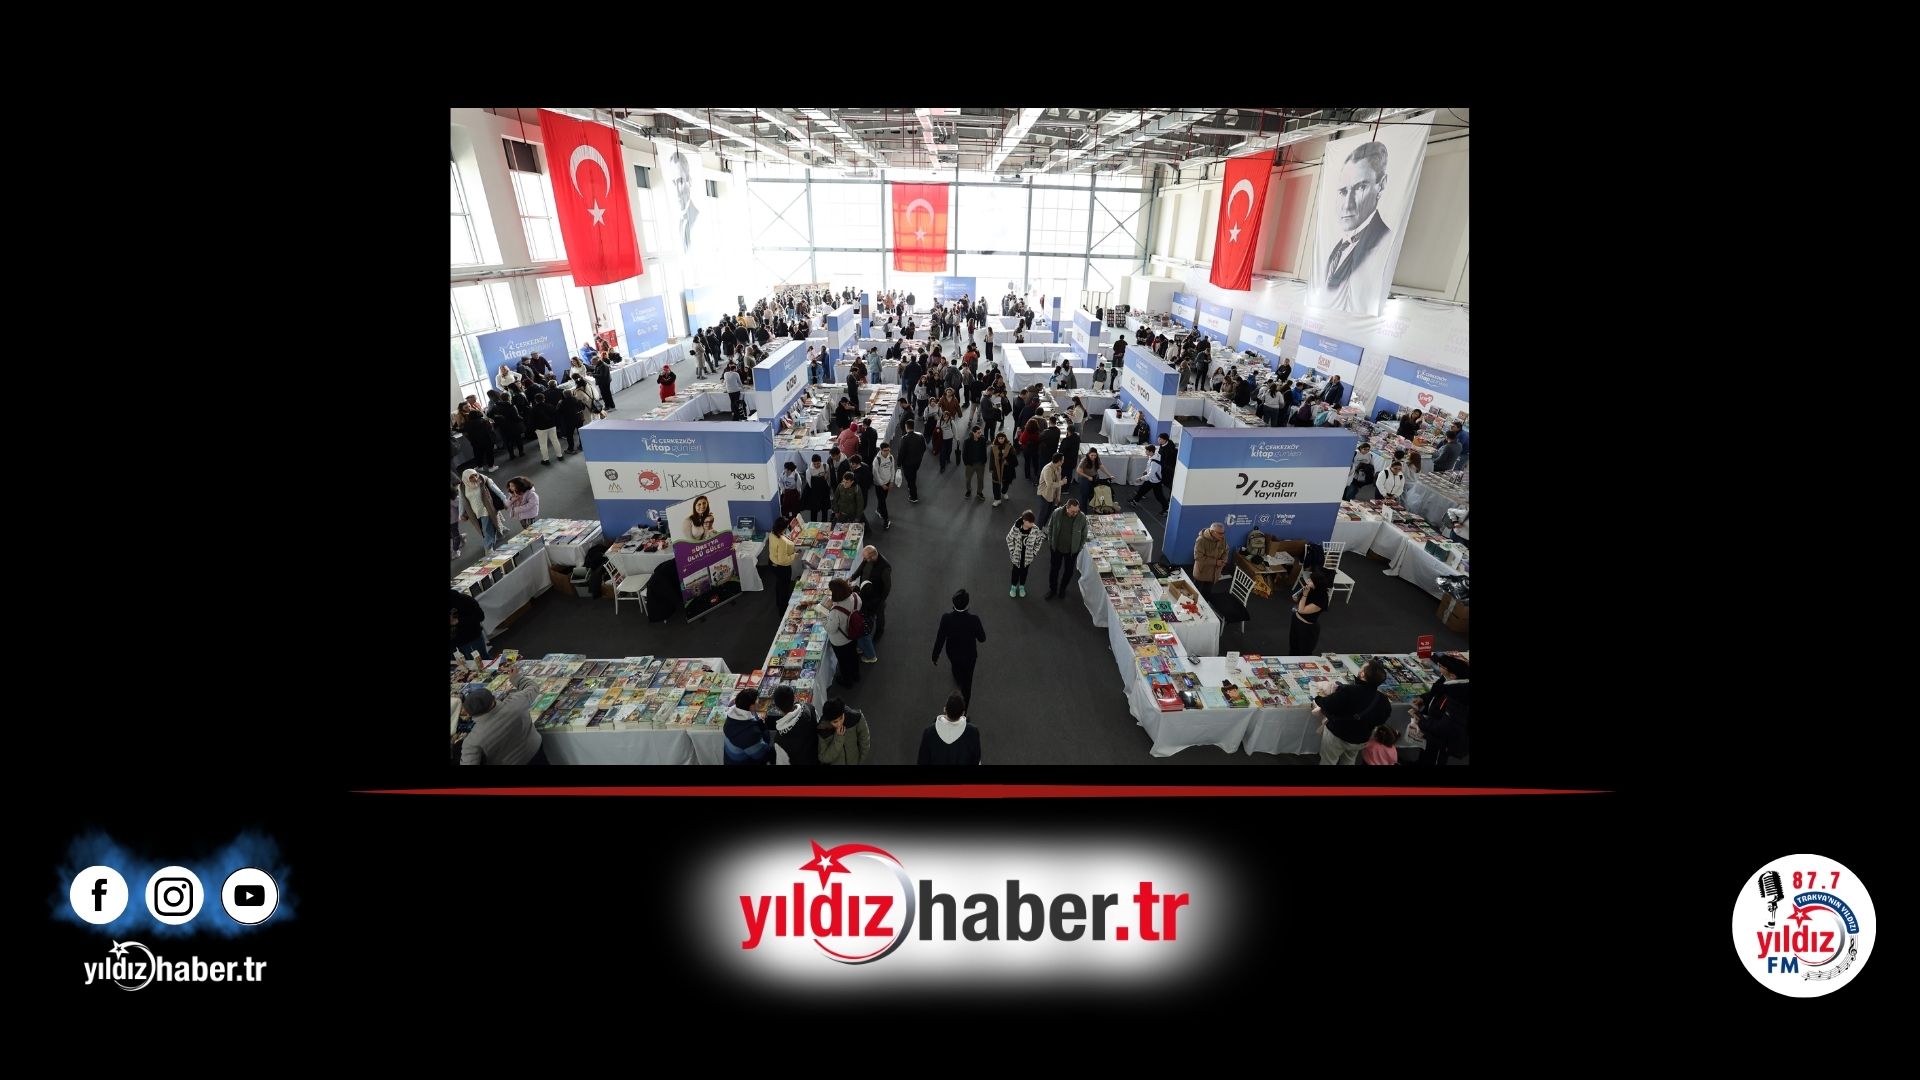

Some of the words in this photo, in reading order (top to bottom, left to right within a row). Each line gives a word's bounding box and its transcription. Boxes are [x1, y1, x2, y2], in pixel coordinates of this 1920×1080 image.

[645, 439, 671, 454] kitap
[1250, 446, 1273, 458] kitap
[1260, 479, 1294, 490] Doğan
[1254, 489, 1298, 500] Yayınları
